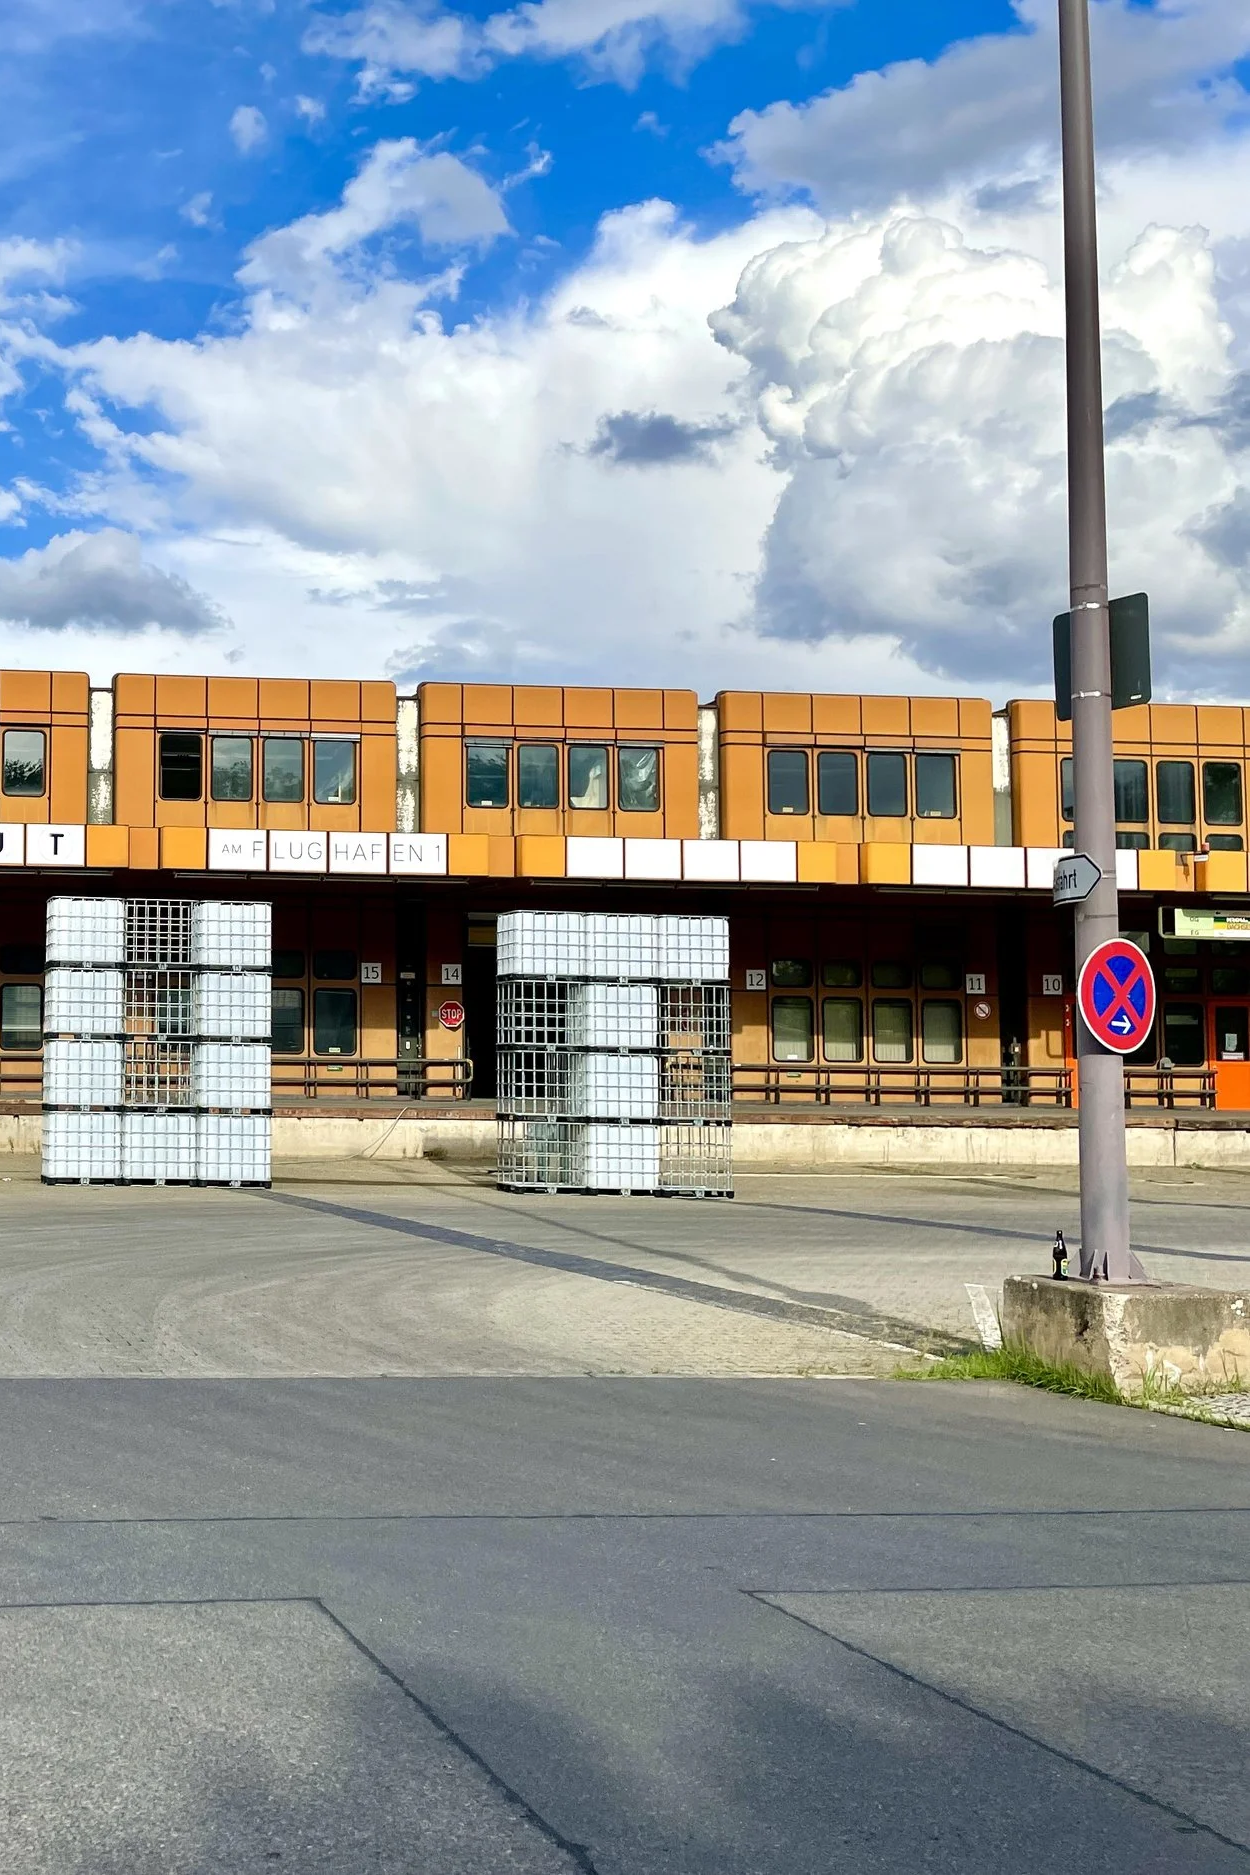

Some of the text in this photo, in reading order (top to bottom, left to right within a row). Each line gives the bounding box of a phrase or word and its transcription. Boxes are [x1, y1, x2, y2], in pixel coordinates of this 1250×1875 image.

[221, 840, 441, 862] AM FLUGHAFEN 1
[363, 966, 380, 980] 15
[443, 967, 460, 981] 14
[748, 973, 764, 987] 12
[969, 977, 983, 990] 11
[1044, 978, 1061, 991] 10
[441, 1008, 462, 1020] STOP
